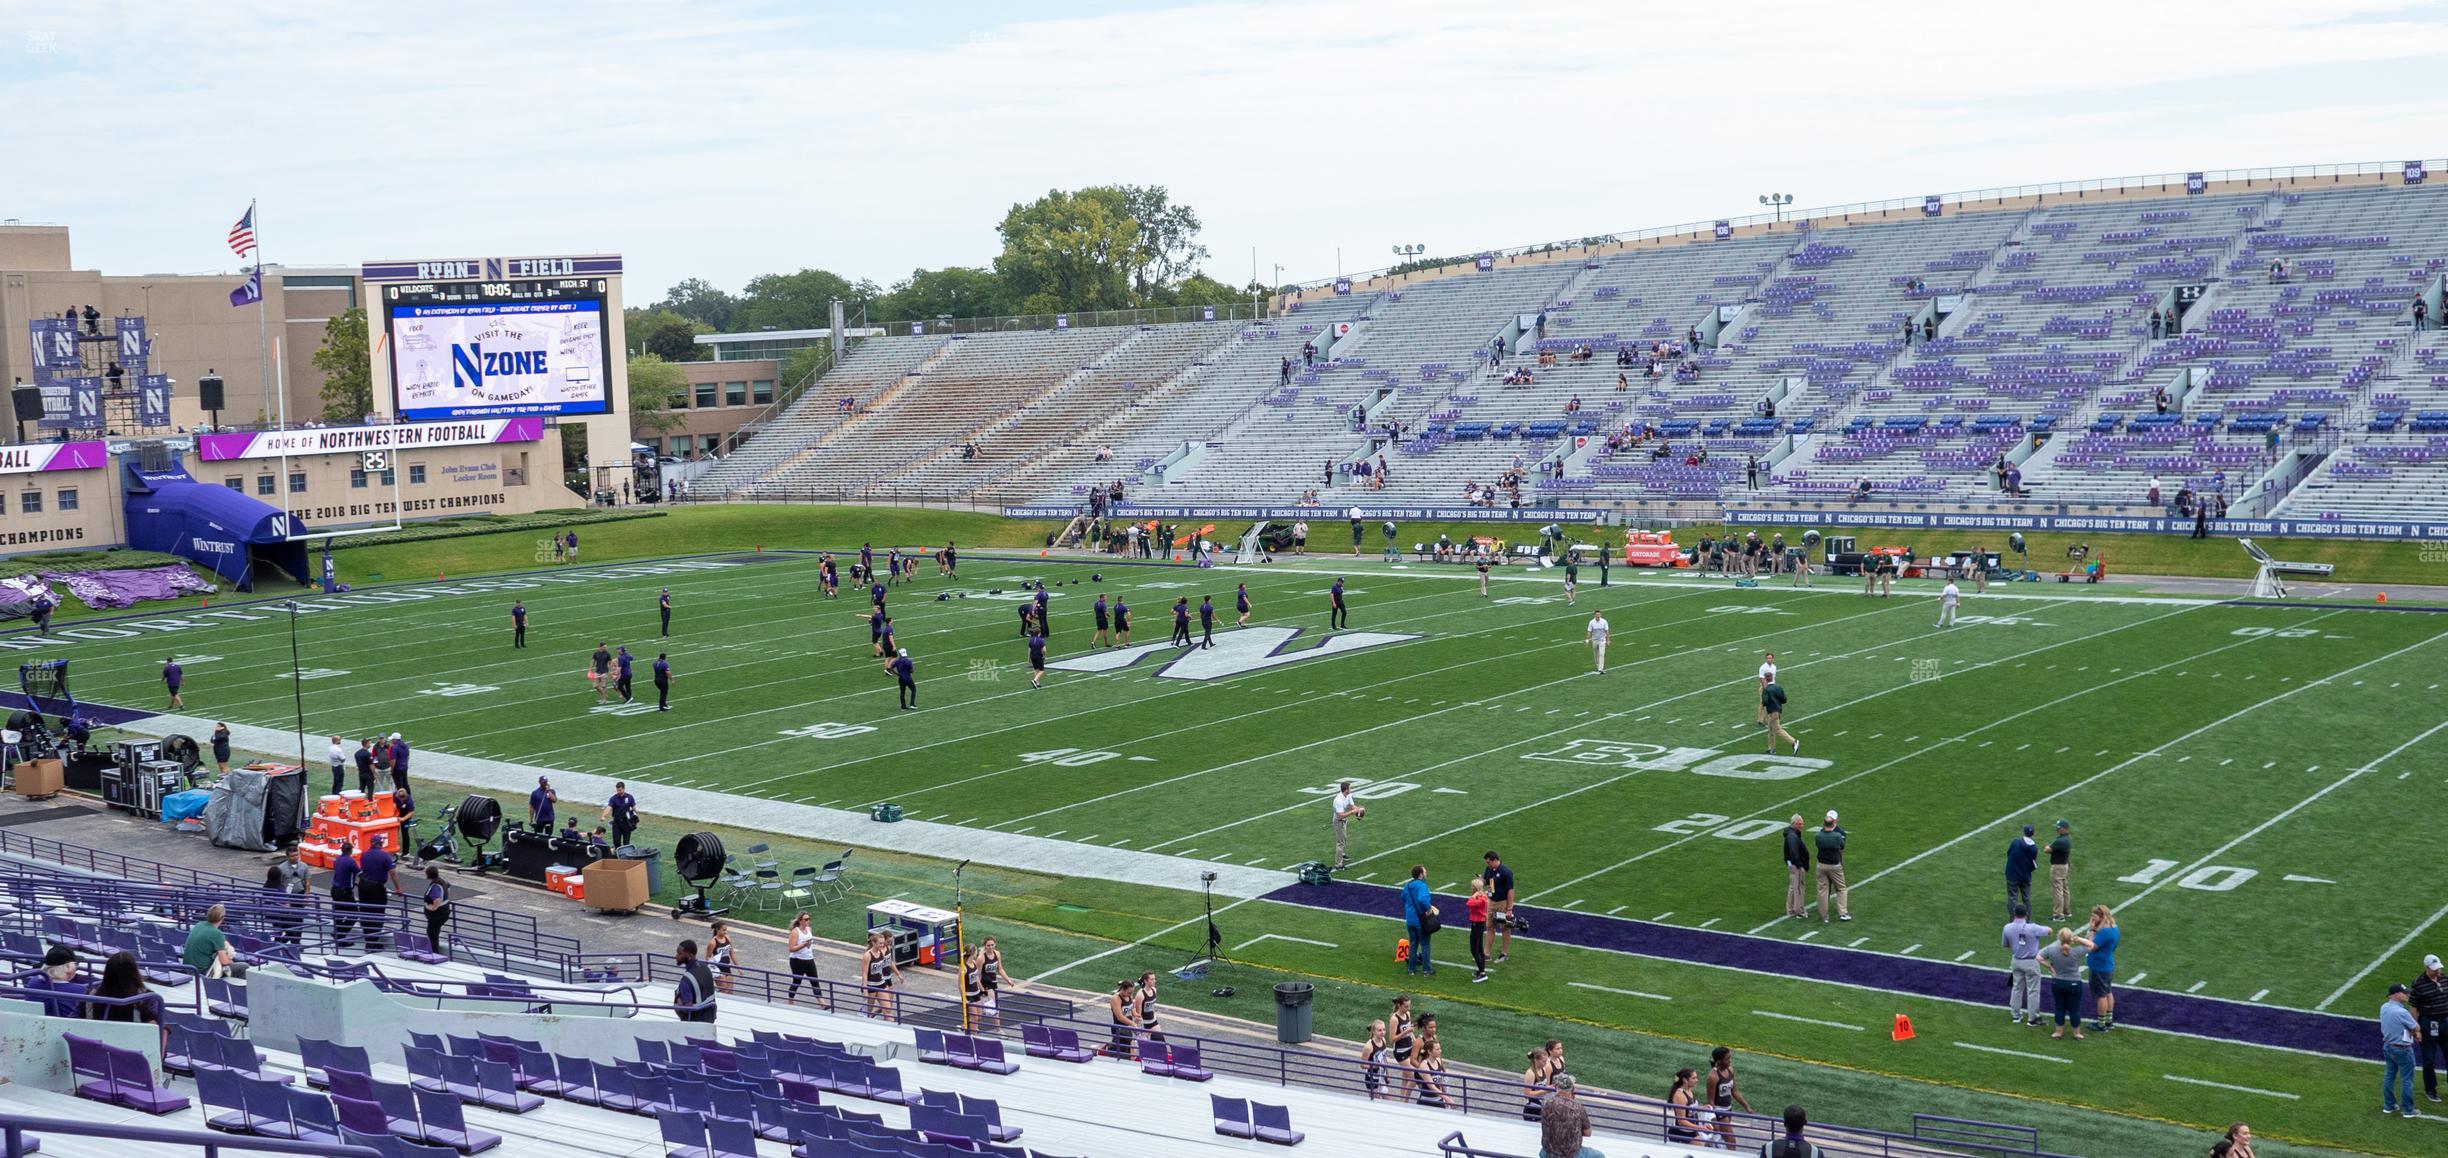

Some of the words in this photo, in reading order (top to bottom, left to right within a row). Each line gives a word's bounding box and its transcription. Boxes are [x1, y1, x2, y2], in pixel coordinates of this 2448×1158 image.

[2406, 168, 2420, 178] 109
[1927, 202, 1938, 210] 107
[1716, 226, 1728, 235] 106
[417, 262, 468, 280] RYAN
[486, 258, 505, 280] N
[520, 259, 574, 276] FIELD
[1480, 259, 1491, 267] 105
[391, 286, 398, 300] 0
[400, 285, 434, 293] WILDCATS
[560, 280, 576, 288] MICH
[598, 280, 606, 292] 0
[1338, 283, 1349, 291] 104
[55, 332, 73, 357] N
[122, 330, 141, 355] N
[474, 330, 500, 342] VISIT
[505, 330, 523, 340] THE
[32, 332, 45, 366] N
[146, 388, 164, 414] N
[472, 388, 484, 398] ON
[488, 386, 534, 402] GAMEDAY!
[78, 390, 96, 416] N
[268, 438, 296, 450] HOME
[302, 436, 313, 448] OF
[320, 427, 422, 449] NORTHWESTERN
[428, 424, 486, 442] FOOTBALL
[366, 452, 386, 469] 25
[442, 466, 457, 474] John
[459, 465, 480, 473] Evans
[480, 464, 496, 472] Club
[453, 474, 476, 482] Locker
[317, 506, 345, 518] 2018
[350, 504, 370, 516] BIG
[375, 500, 397, 514] TEN
[403, 498, 435, 511] WEST
[440, 493, 505, 508] CHAMPIONS
[1426, 510, 1432, 518] N
[272, 516, 285, 536] N
[1726, 513, 1732, 521] N
[1738, 513, 1771, 522] CHICAGO'S
[1773, 514, 1784, 522] BIG
[1786, 514, 1799, 522] TEN
[1800, 514, 1819, 522] TEAM
[1930, 516, 1937, 525] N
[1944, 517, 1981, 525] CHICAGO'S
[1982, 517, 1995, 526] BIG
[1996, 518, 2011, 526] TEN
[2012, 518, 2033, 526] TEAM
[2040, 518, 2047, 527] N
[2054, 519, 2094, 527] CHICAGO'S
[2095, 519, 2108, 528] BIG
[2110, 520, 2125, 529] TEN
[2127, 521, 2149, 529] TEAM
[2280, 523, 2288, 533] N
[2296, 524, 2340, 533] CHICAGO'S
[2341, 524, 2356, 534] BIG
[2358, 525, 2376, 534] TEN
[2378, 526, 2402, 535] TEAM
[2411, 526, 2419, 536] N
[193, 538, 234, 554] WINTRUST
[326, 559, 334, 570] N
[1044, 626, 1426, 681] N
[777, 722, 879, 739] 50
[1017, 748, 1122, 766] 40
[1296, 777, 1422, 799] 30
[1651, 813, 1791, 840] 20
[2116, 858, 2259, 891] 10
[567, 885, 573, 896] G
[1899, 1020, 1909, 1032] 10
